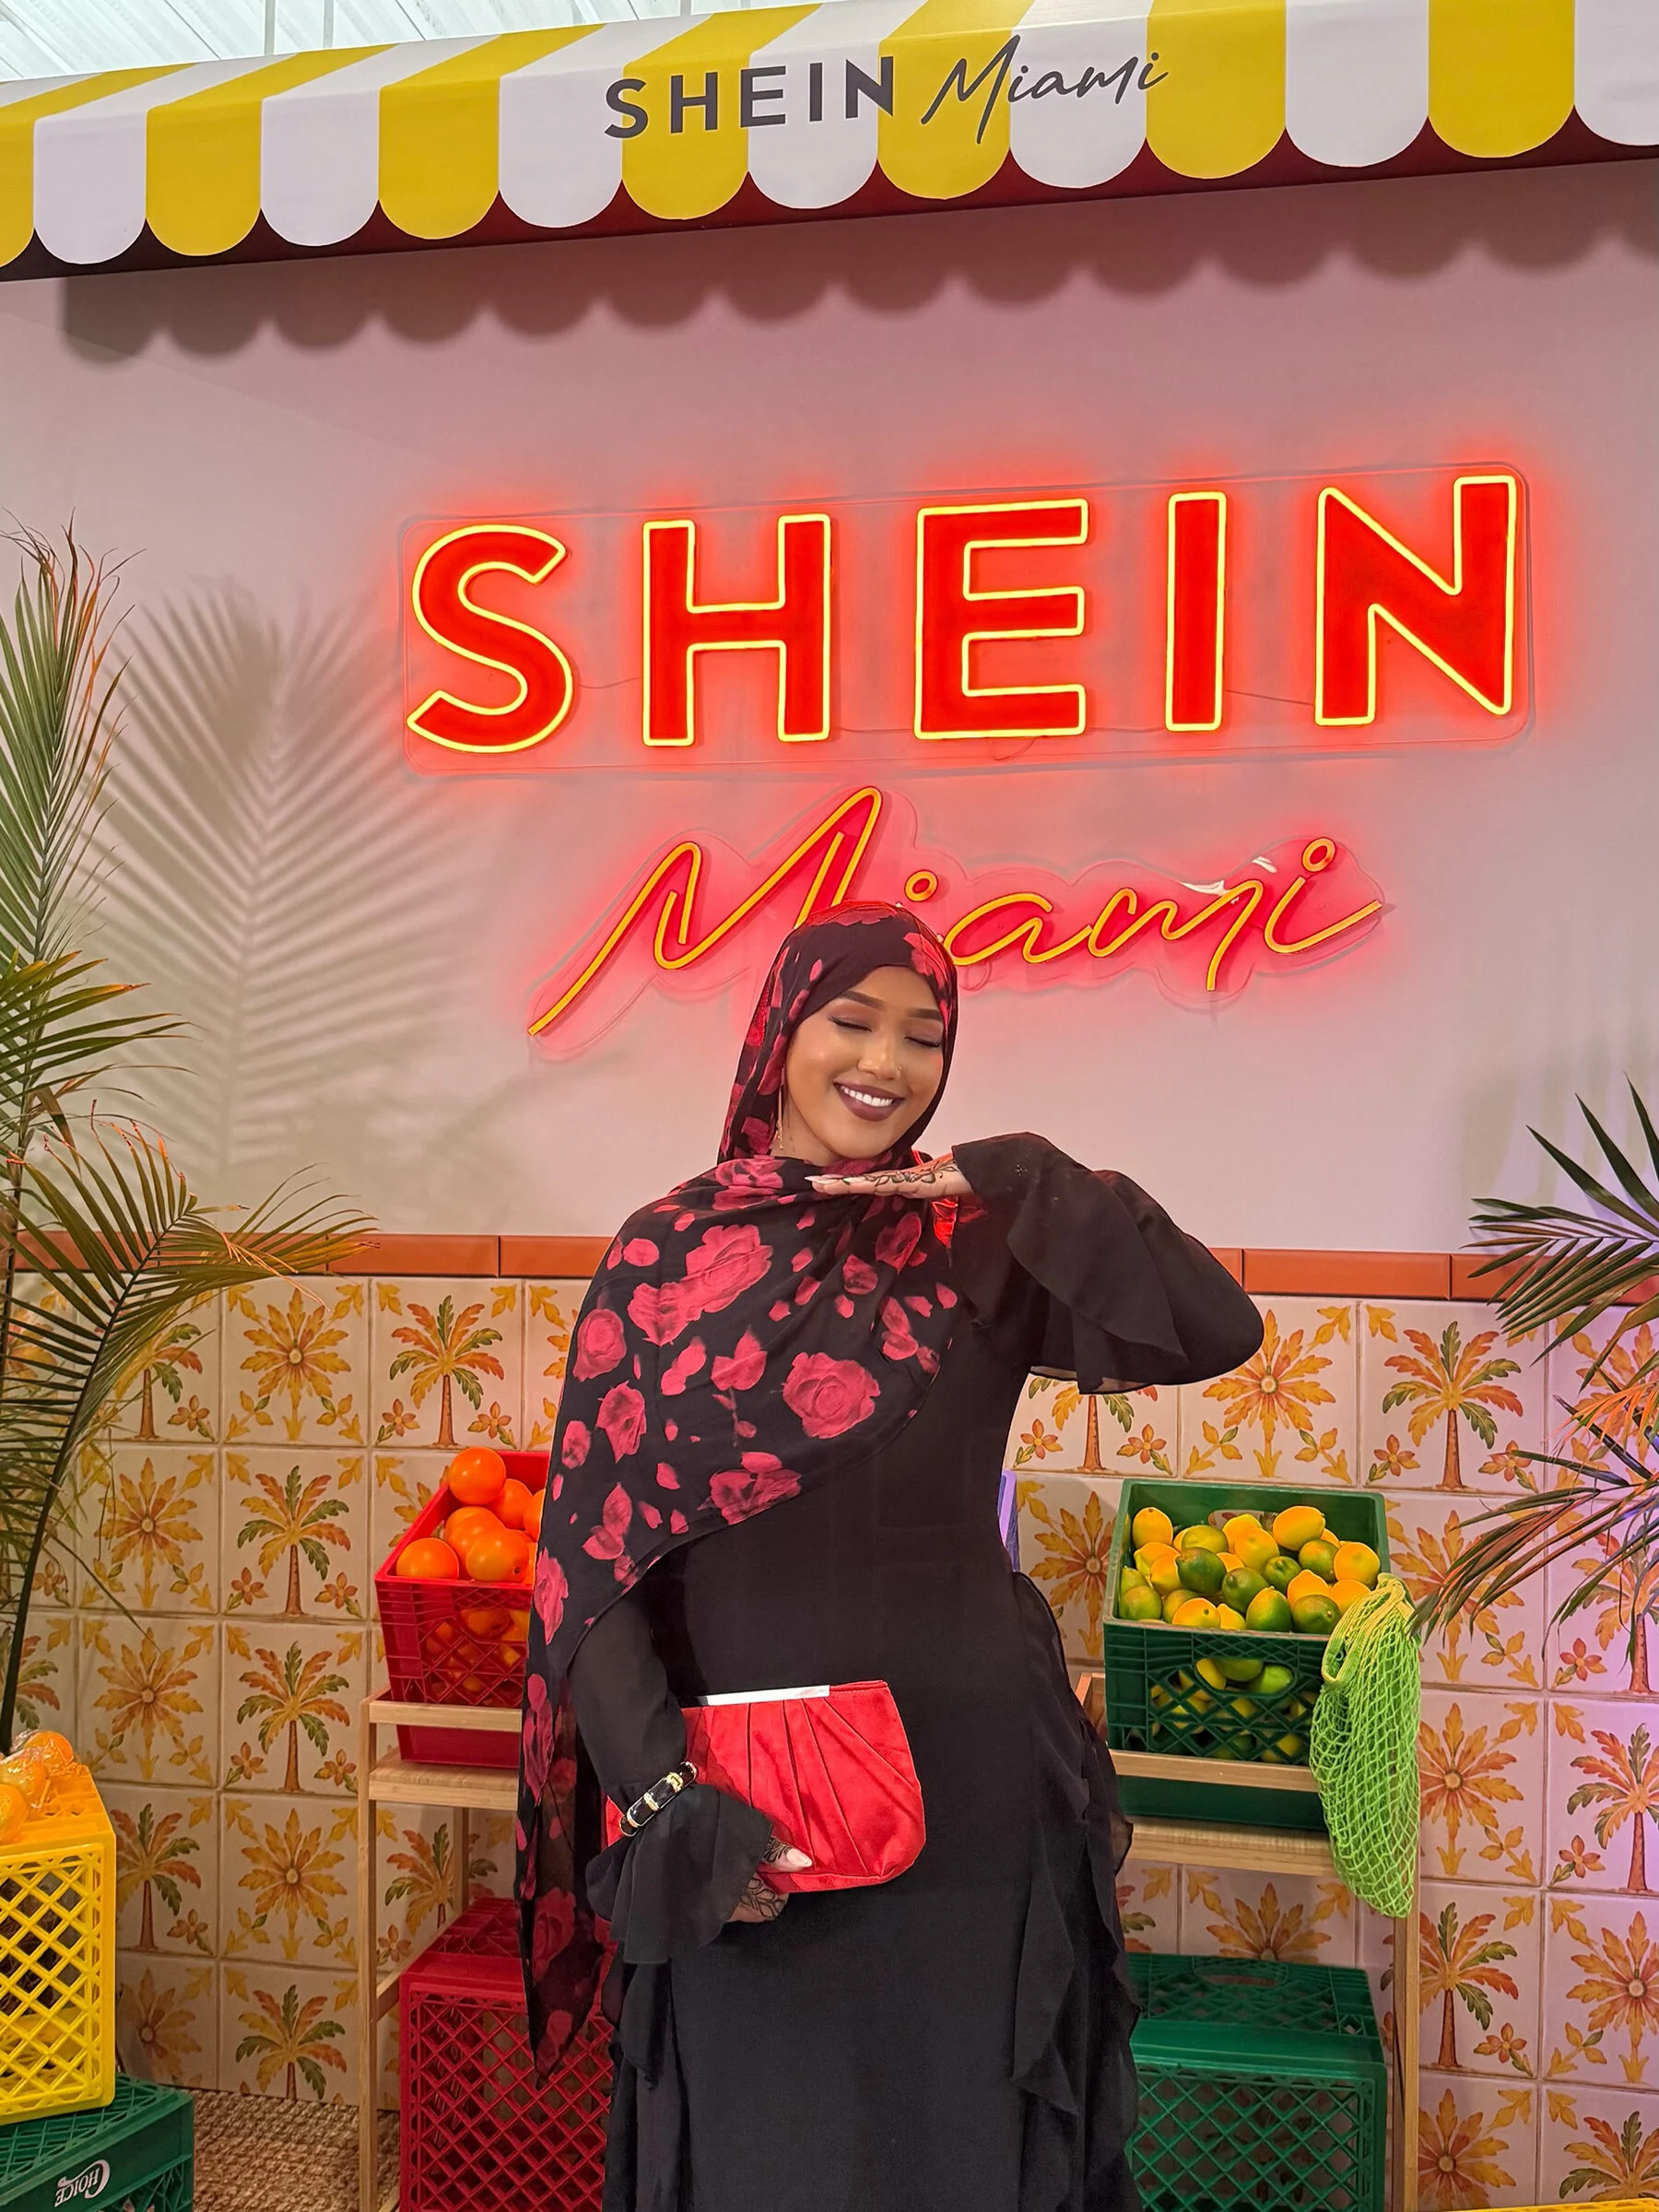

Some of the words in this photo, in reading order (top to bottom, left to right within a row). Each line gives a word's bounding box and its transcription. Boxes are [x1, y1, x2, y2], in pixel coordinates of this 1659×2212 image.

[604, 54, 895, 139] SHEIN
[920, 34, 1169, 145] Miami
[406, 475, 1518, 753] SHEIN
[54, 2159, 111, 2207] CHOICE
